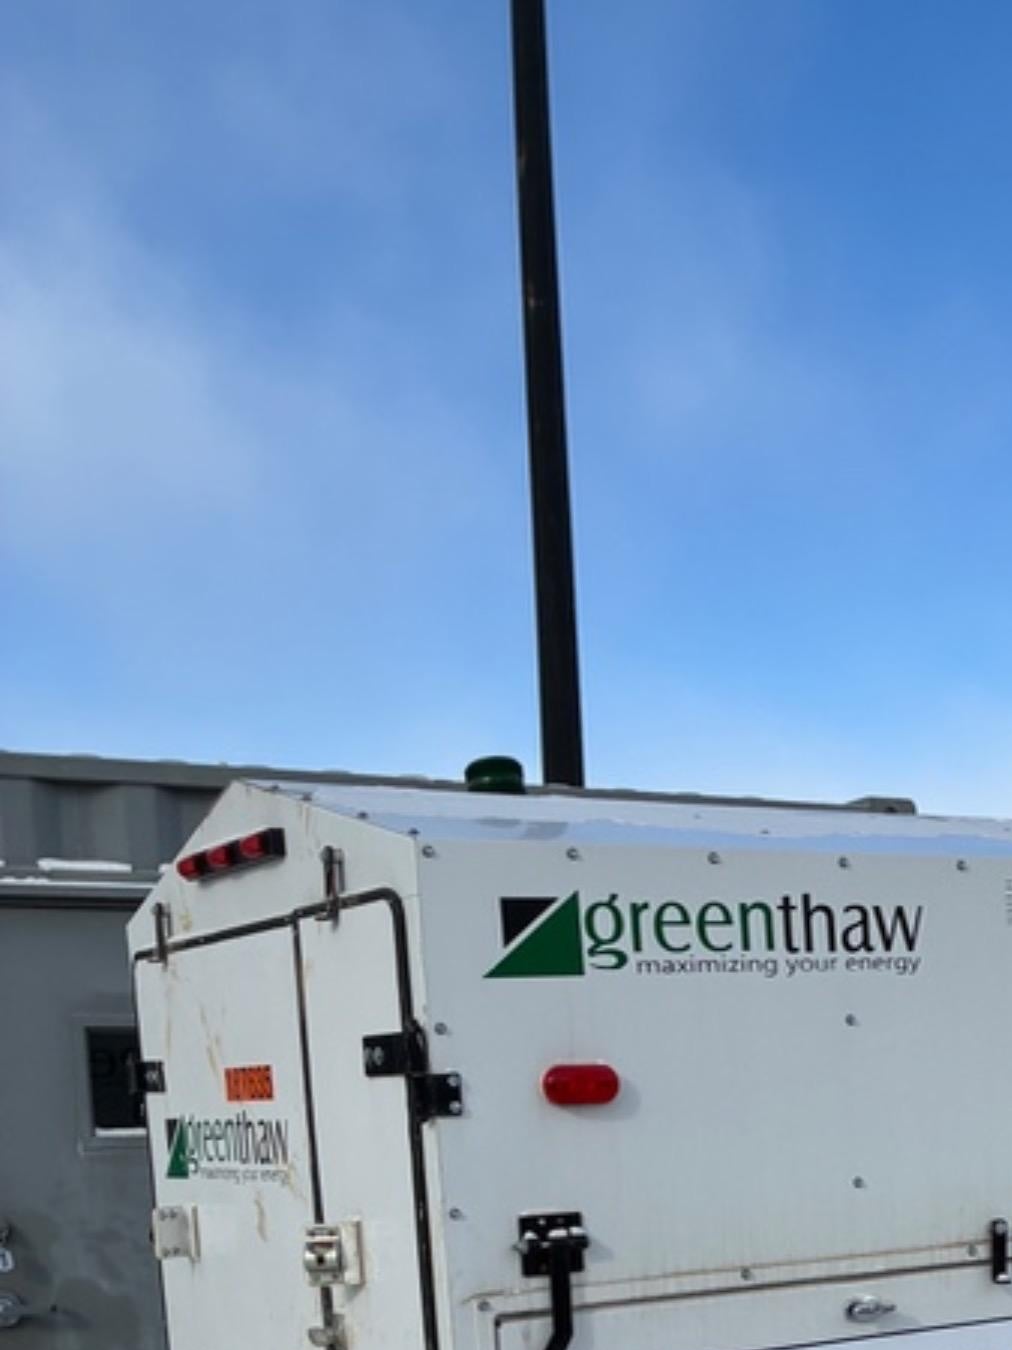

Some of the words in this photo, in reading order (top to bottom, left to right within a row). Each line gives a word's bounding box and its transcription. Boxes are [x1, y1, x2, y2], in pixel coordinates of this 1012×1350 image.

[584, 893, 923, 970] greenthaw
[636, 955, 779, 977] maximizing
[786, 955, 838, 977] your
[845, 953, 921, 975] energy
[184, 1110, 288, 1174] greenthaw
